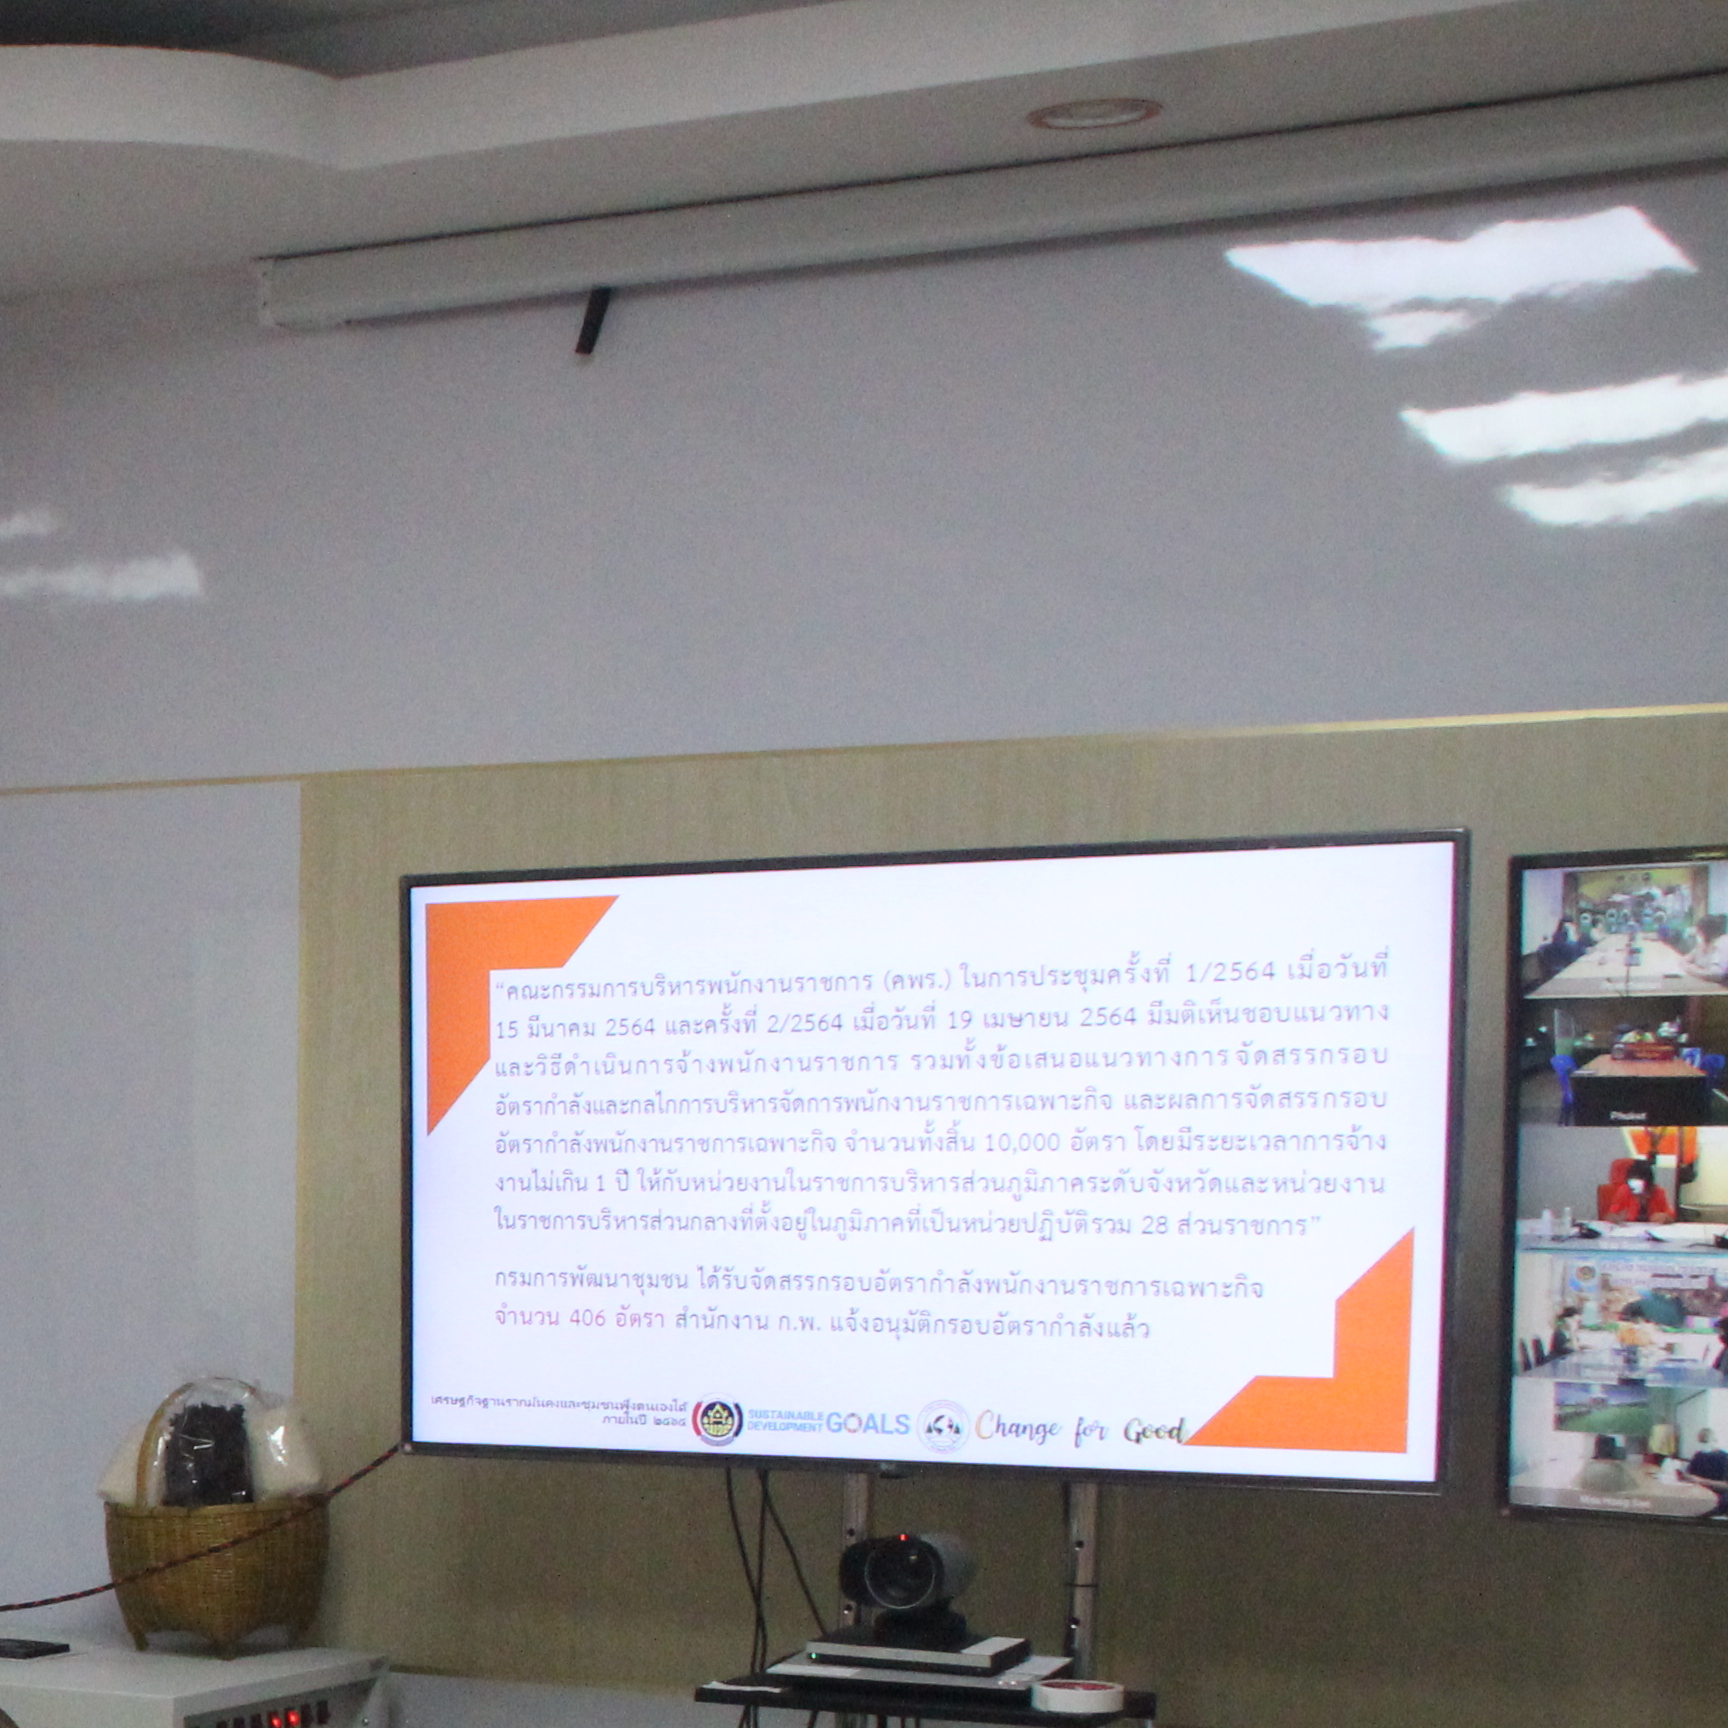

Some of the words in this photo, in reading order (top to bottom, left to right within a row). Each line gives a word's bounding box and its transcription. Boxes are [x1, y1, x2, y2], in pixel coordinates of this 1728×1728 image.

[496, 969, 875, 1001] “คณะกรรมการบริหารพนักงานราชการ
[883, 968, 953, 993] (คพร.)
[958, 949, 1175, 994] ในการประชุมครั้งที่
[1187, 960, 1279, 984] 1/2564
[1287, 945, 1391, 980] เมื่อวันที่
[497, 1019, 521, 1040] 15
[527, 1013, 598, 1039] มีนาคม
[604, 1016, 657, 1038] 2564
[665, 1002, 760, 1036] และครั้งที่
[766, 1011, 846, 1034] 2/2564
[853, 998, 938, 1032] เมื่อวันที่
[948, 1009, 976, 1030] 19
[982, 1010, 1072, 1029] เมษายน
[1079, 1005, 1140, 1028] 2564
[1147, 996, 1392, 1026] มีมติเห็นชอบแนวทาง
[495, 1048, 901, 1078] และวิธีดำเนินการจ้างพนักงานราชการ
[1124, 1082, 1390, 1111] และผลการจัดสรรกรอบ
[495, 1128, 840, 1155] อัตรากำลังพนักงานราชการเฉพาะกิจ
[844, 1118, 977, 1153] จำนวนทั้งสิ้น
[985, 1131, 1062, 1155] 10,000
[1070, 1126, 1128, 1153] อัตรา
[1133, 1123, 1389, 1152] โดยมีระยะเวลาการจ้าง
[495, 1167, 589, 1193] งานไม่เกิน
[596, 1173, 606, 1193] 1
[614, 1166, 633, 1193] ปี
[1140, 1214, 1171, 1235] 28
[1177, 1210, 1323, 1237] ส่วนราชการ”
[495, 1263, 690, 1298] กรมการพัฒนาชุมชน
[494, 1301, 560, 1327] จำนวน
[568, 1308, 607, 1328] 406
[614, 1303, 665, 1329] อัตรา
[675, 1304, 771, 1331] สำนักงาน
[778, 1314, 822, 1332] ก.พ.
[830, 1306, 1153, 1342] แจ้งอนุมัติกรอบอัตรากำลังแล้ว
[747, 1409, 825, 1421] SUSTAINABLE
[747, 1420, 824, 1432] DEVELOPMENT
[826, 1411, 911, 1435] GOALS
[974, 1408, 1064, 1447] Change
[1073, 1415, 1111, 1450] for
[1122, 1415, 1189, 1448] Good
